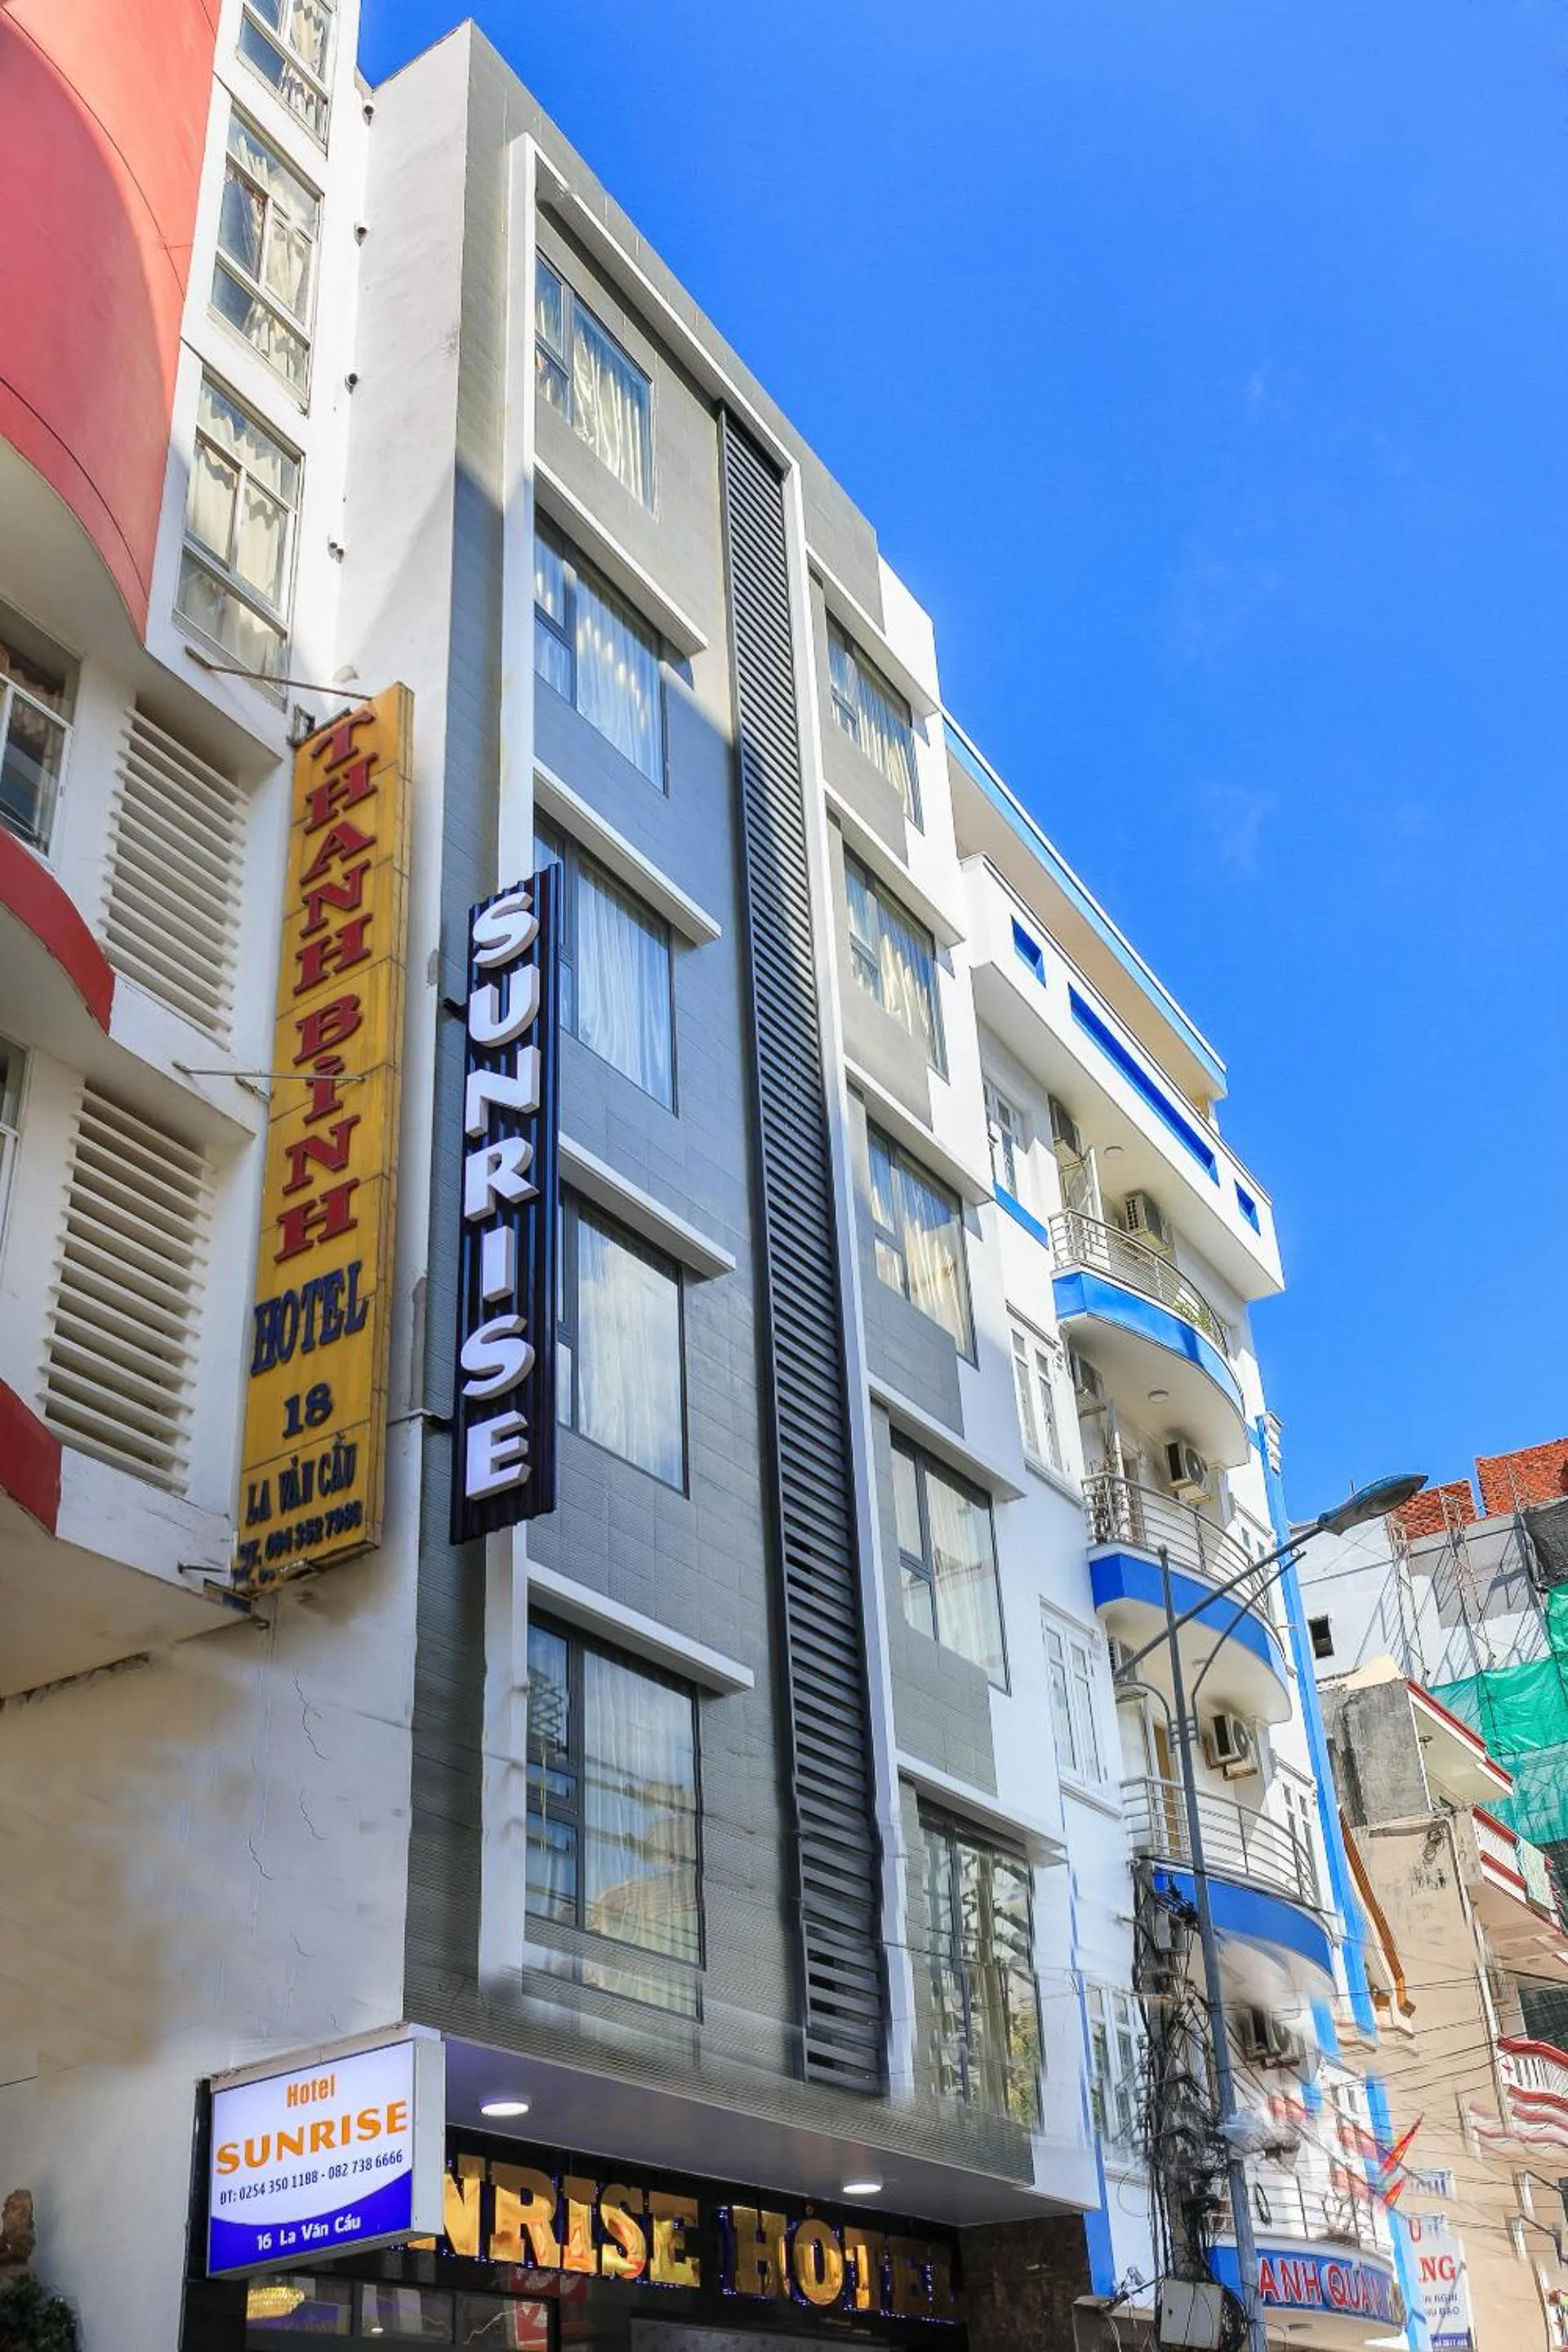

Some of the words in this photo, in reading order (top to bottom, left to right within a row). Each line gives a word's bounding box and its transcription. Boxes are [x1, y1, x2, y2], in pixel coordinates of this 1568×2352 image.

[292, 708, 376, 998] THANH
[461, 891, 541, 1502] SUNRISE
[250, 1260, 370, 1378] HOTEL
[281, 1383, 333, 1439] 18
[286, 2073, 336, 2108] Hotel
[215, 2100, 408, 2176] SUNRISE
[239, 2184, 266, 2202] 0254
[269, 2178, 288, 2194] 350
[291, 2171, 318, 2189] 1188
[328, 2163, 349, 2180] 082
[352, 2158, 372, 2174] 738
[375, 2149, 403, 2168] 6666
[256, 2233, 272, 2251] 16
[279, 2229, 296, 2247] La
[408, 2154, 701, 2287] NRISE
